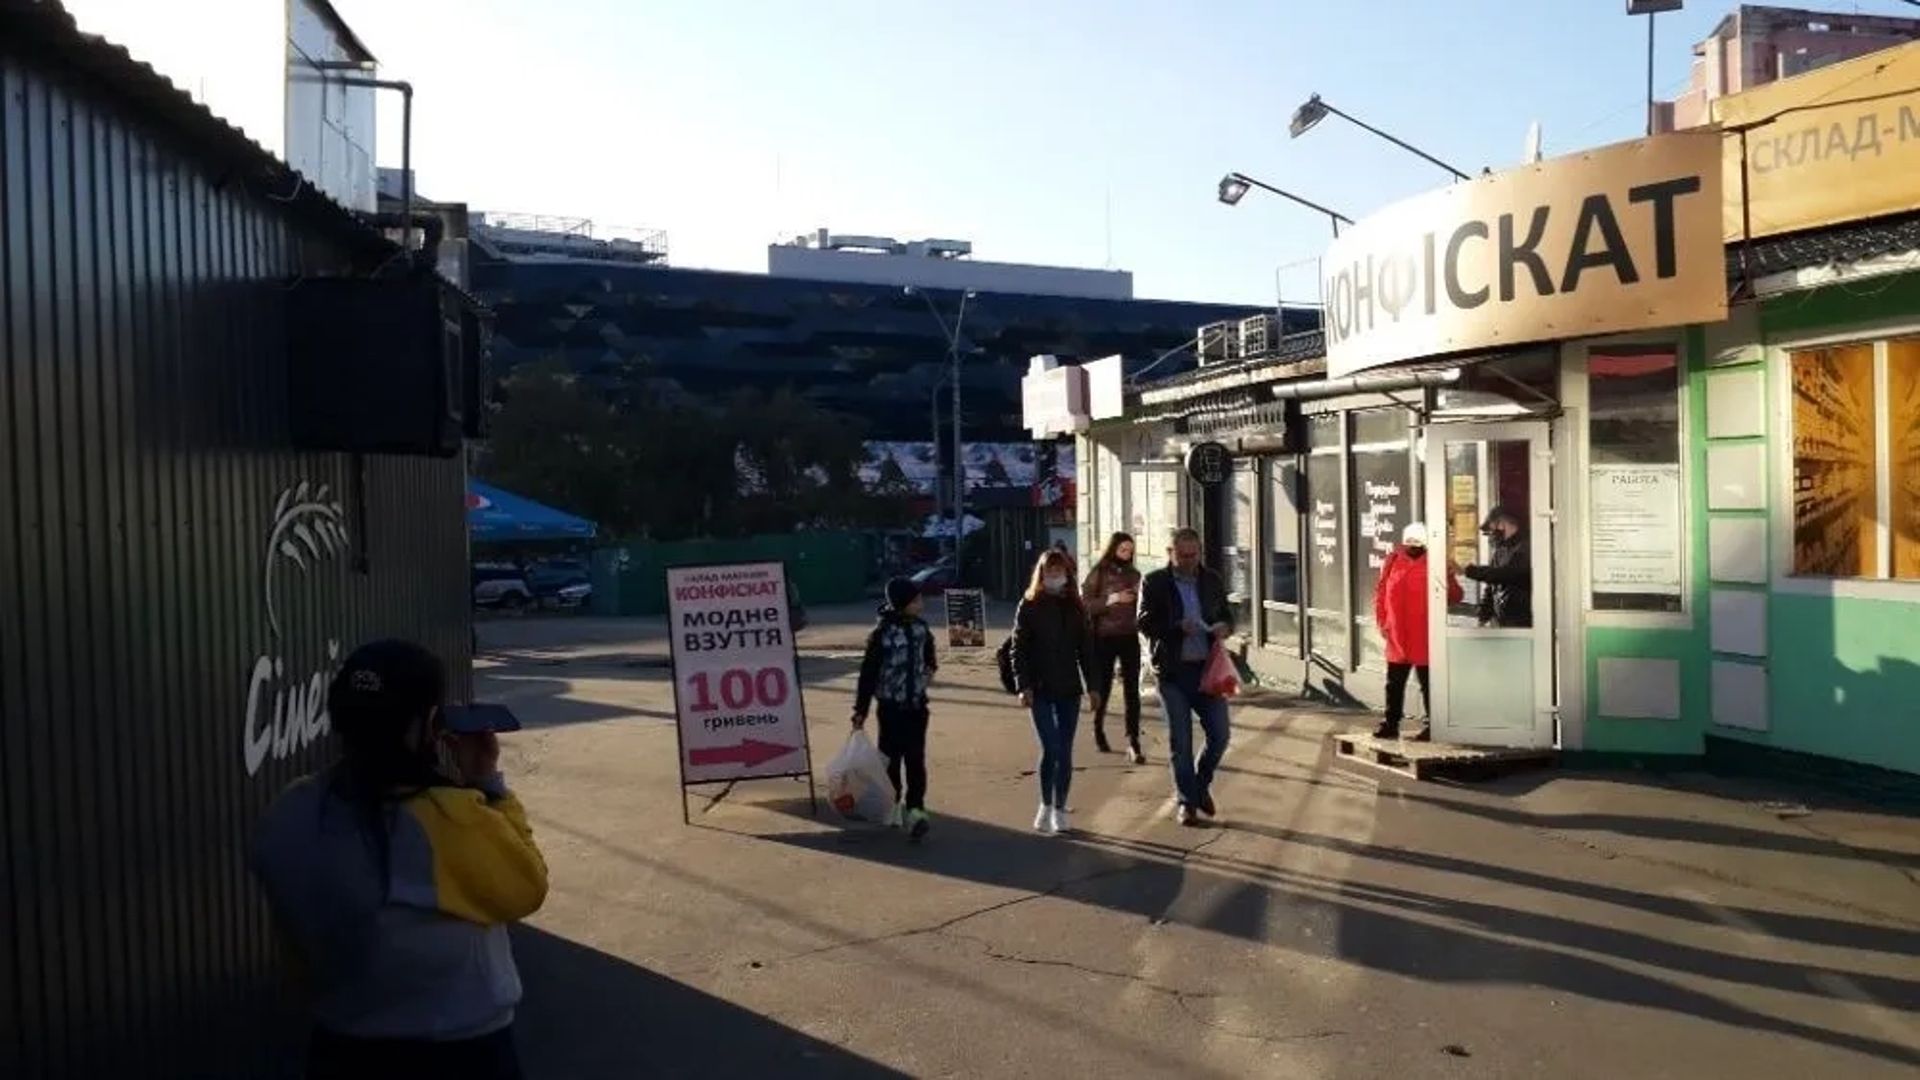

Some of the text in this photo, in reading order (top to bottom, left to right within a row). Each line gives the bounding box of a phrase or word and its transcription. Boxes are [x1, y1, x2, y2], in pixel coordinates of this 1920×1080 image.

[1325, 175, 1702, 347] КОНФІСКАТ
[675, 581, 780, 601] КОНФІСКАТ
[688, 667, 788, 712] 100
[704, 713, 779, 732] гривень
